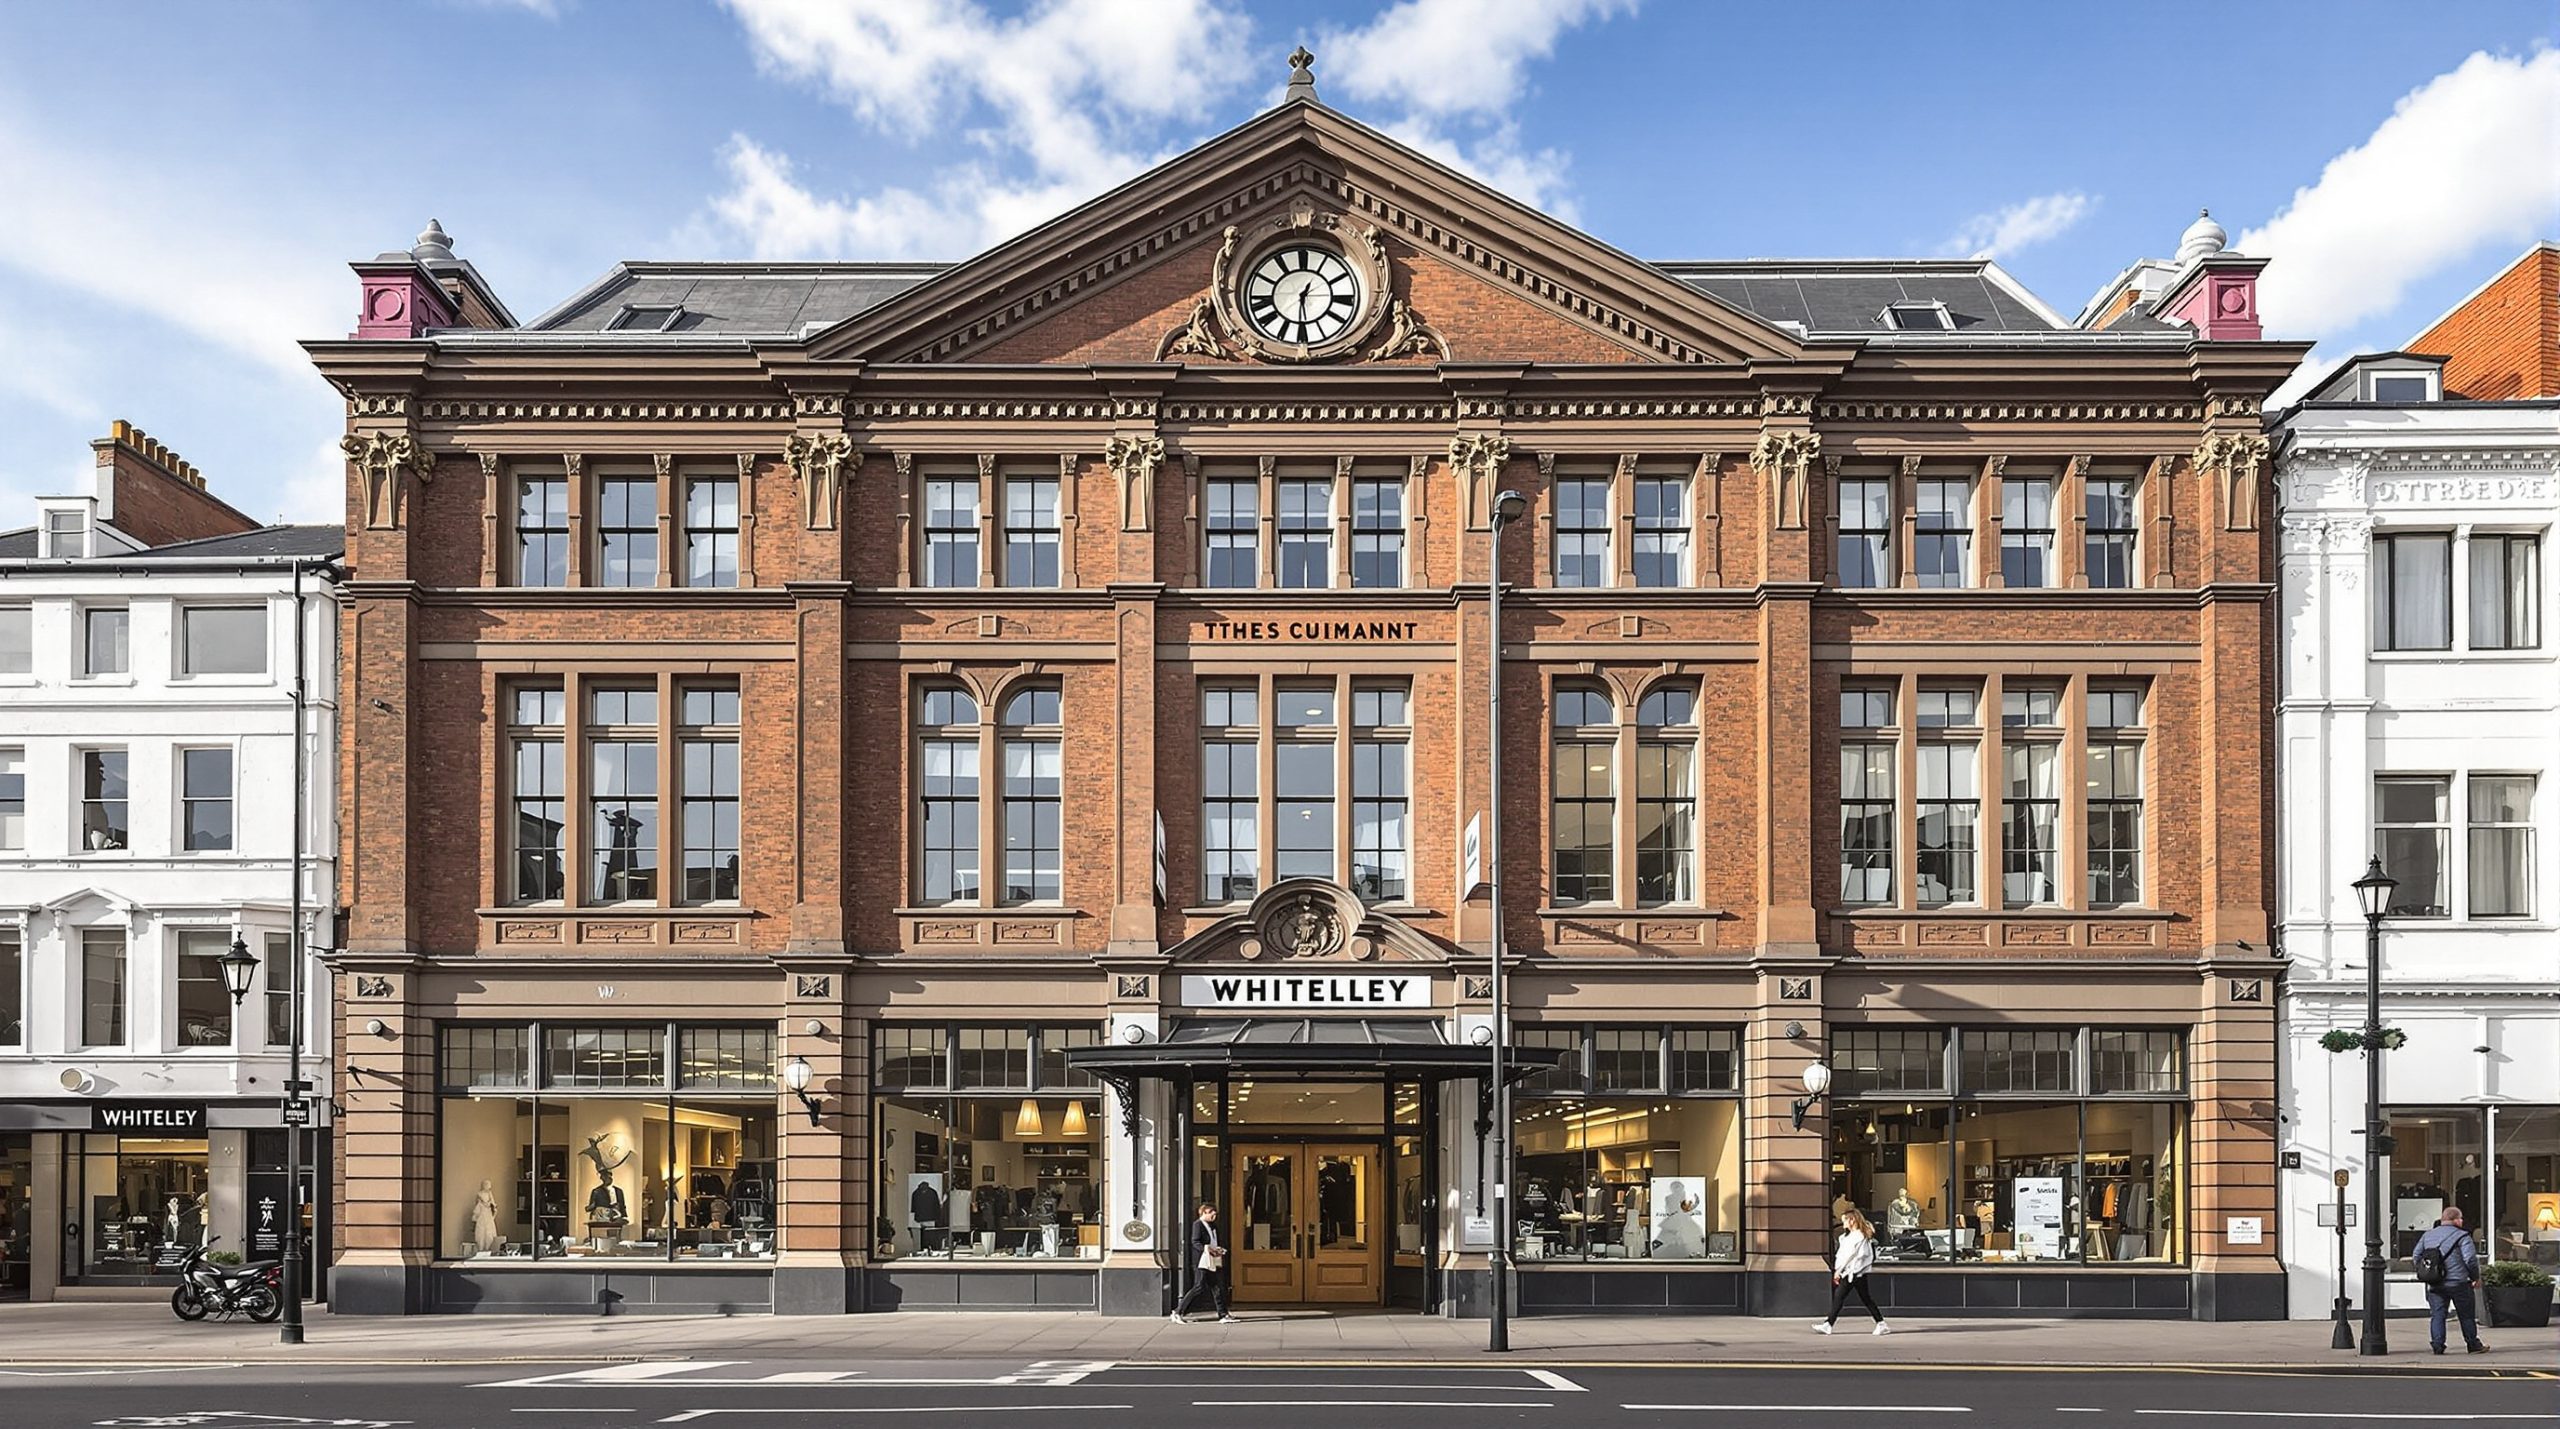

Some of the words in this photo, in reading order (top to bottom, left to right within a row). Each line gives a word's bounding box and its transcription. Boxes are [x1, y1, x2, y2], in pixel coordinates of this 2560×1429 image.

[1204, 622, 1280, 640] TTHES
[1289, 622, 1418, 640] CUIMANNT
[1211, 979, 1409, 1002] WHITELLEY
[102, 1109, 198, 1126] WHITELEY
